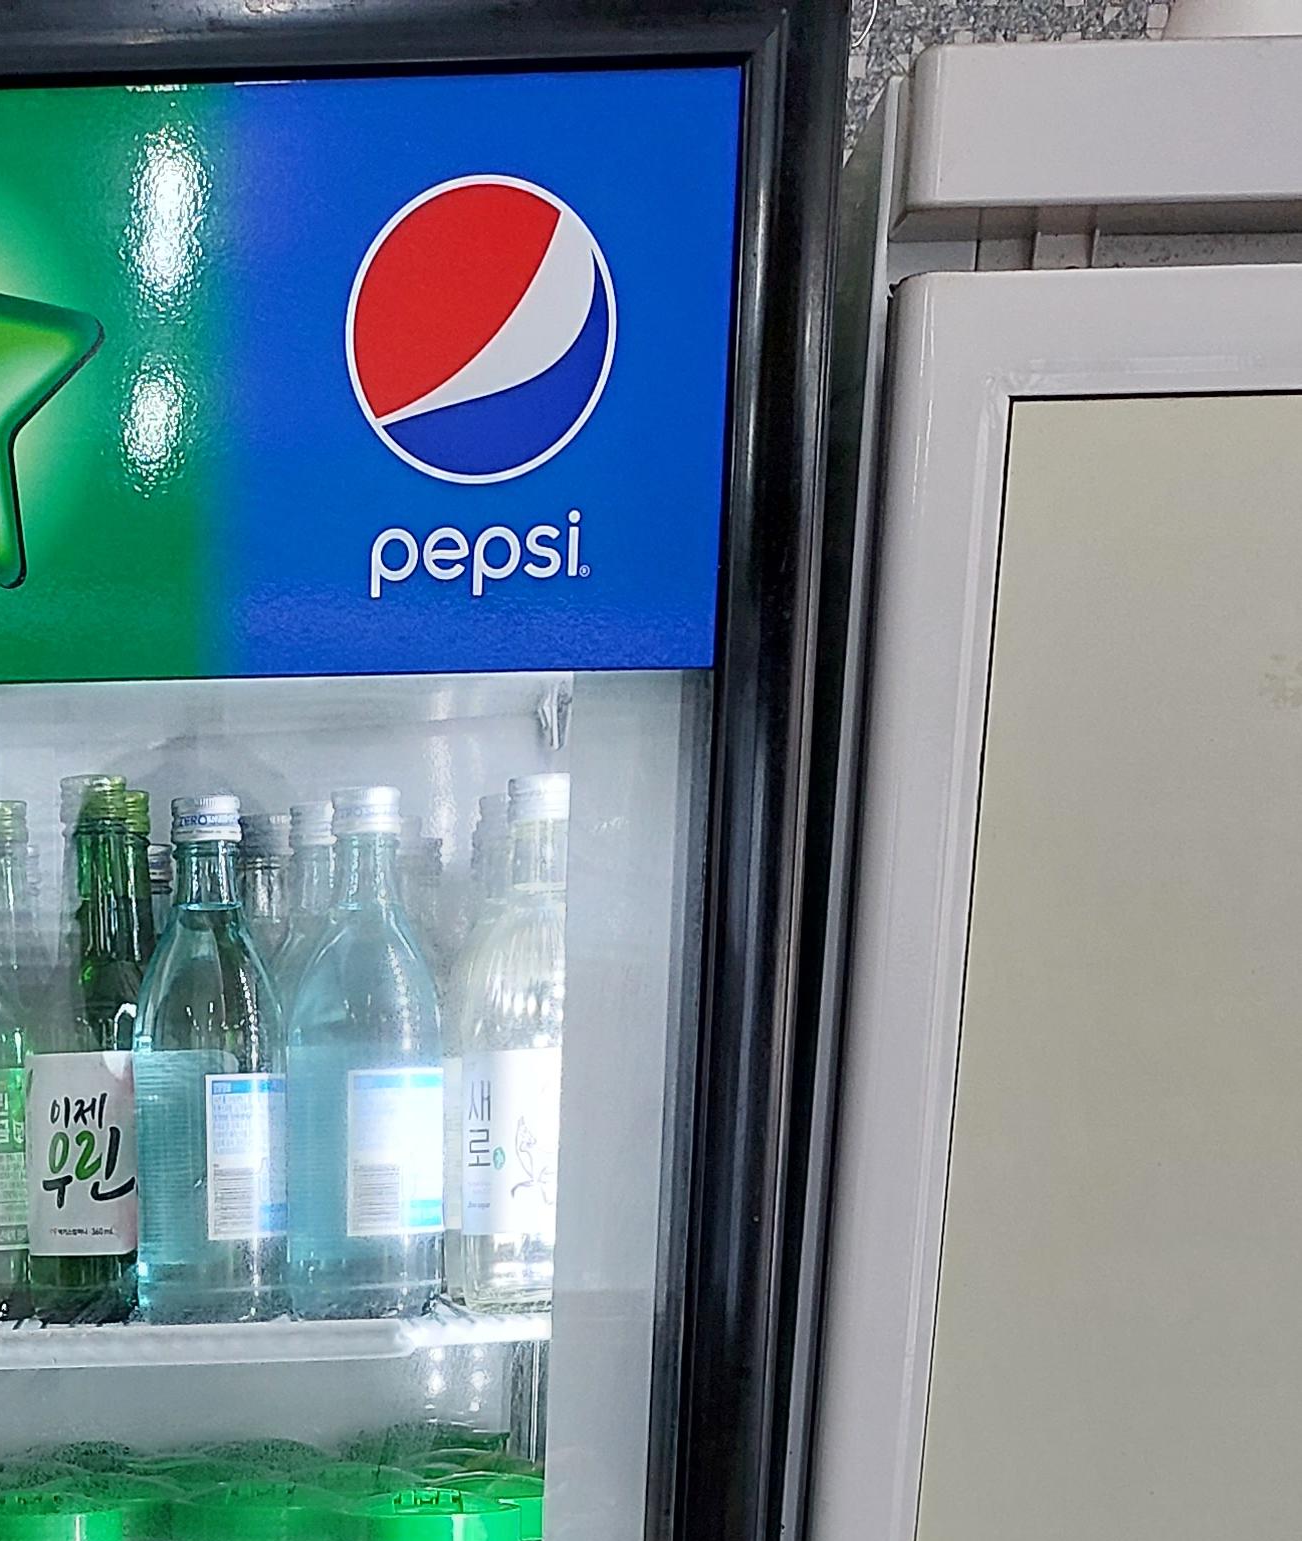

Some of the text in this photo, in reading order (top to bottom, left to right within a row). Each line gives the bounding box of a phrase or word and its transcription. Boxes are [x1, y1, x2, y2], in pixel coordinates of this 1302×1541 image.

[370, 509, 582, 599] pepsi
[50, 1091, 108, 1130] 이제
[467, 1079, 491, 1168] 새로
[41, 1125, 136, 1210] 우린
